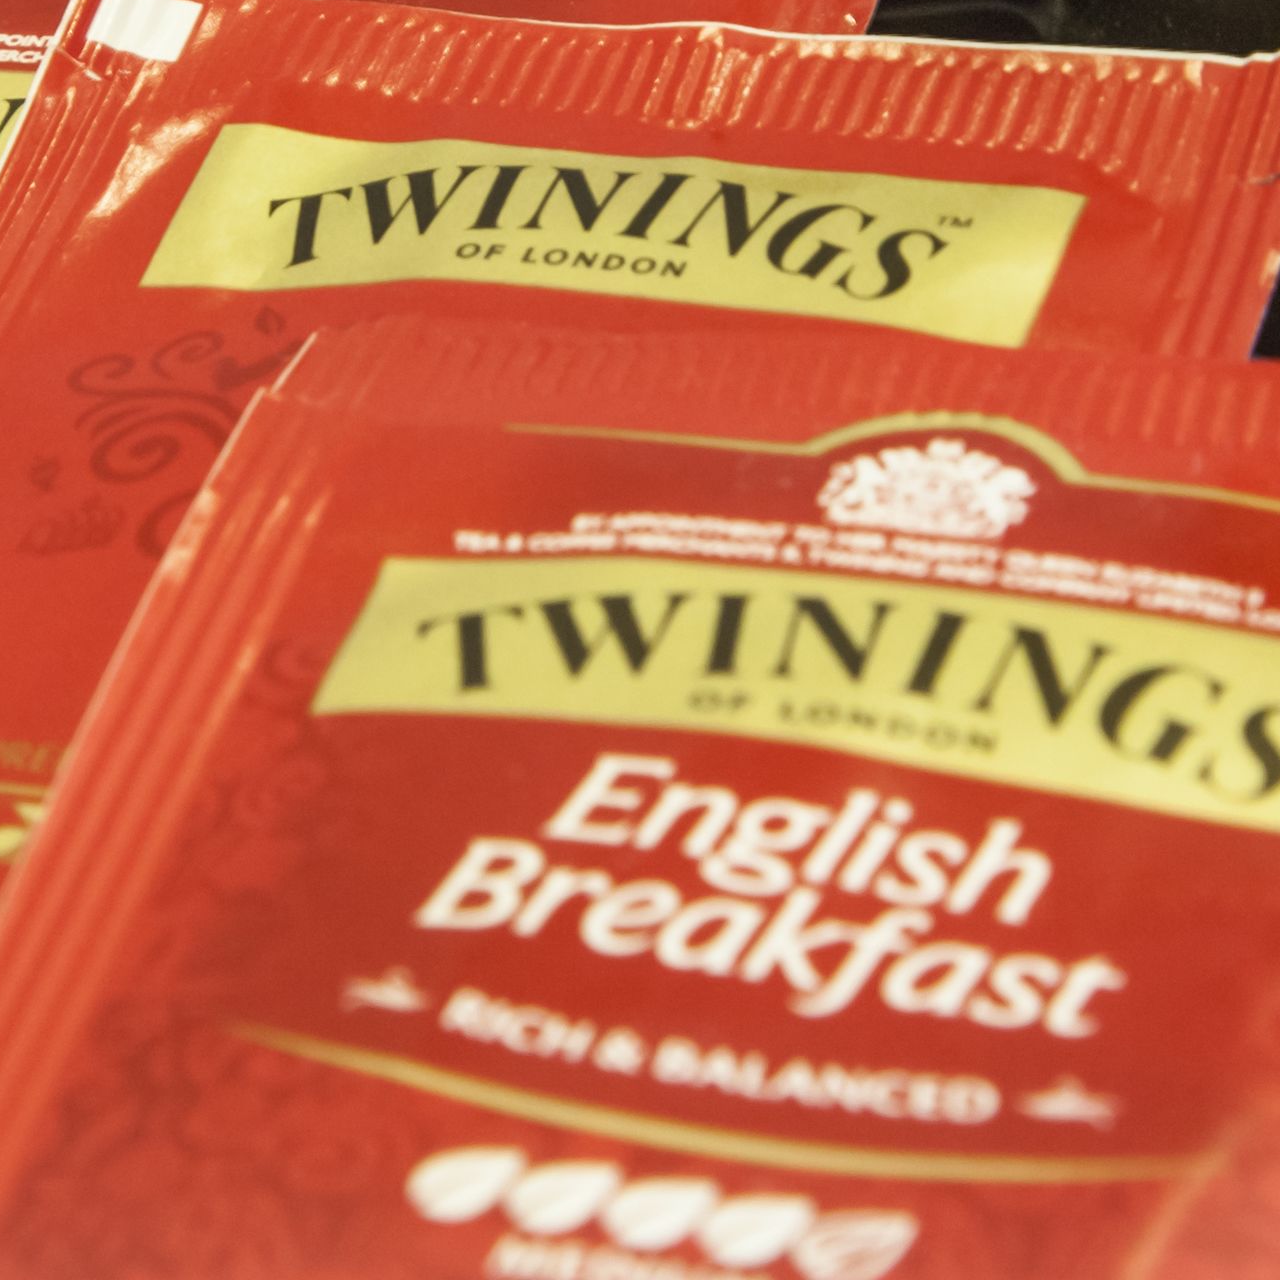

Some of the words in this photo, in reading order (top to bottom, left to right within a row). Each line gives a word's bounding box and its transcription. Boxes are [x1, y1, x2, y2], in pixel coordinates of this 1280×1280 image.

[267, 164, 950, 301] TWININGS
[454, 241, 507, 260] OF
[519, 246, 688, 279] LONDON
[685, 686, 750, 716] OF
[777, 698, 998, 756] LONDON
[542, 751, 1054, 927] English
[413, 834, 1128, 1040] Breakfast
[437, 982, 600, 1064] RICH
[591, 1025, 648, 1076] &
[650, 1033, 1003, 1126] BALANCED
